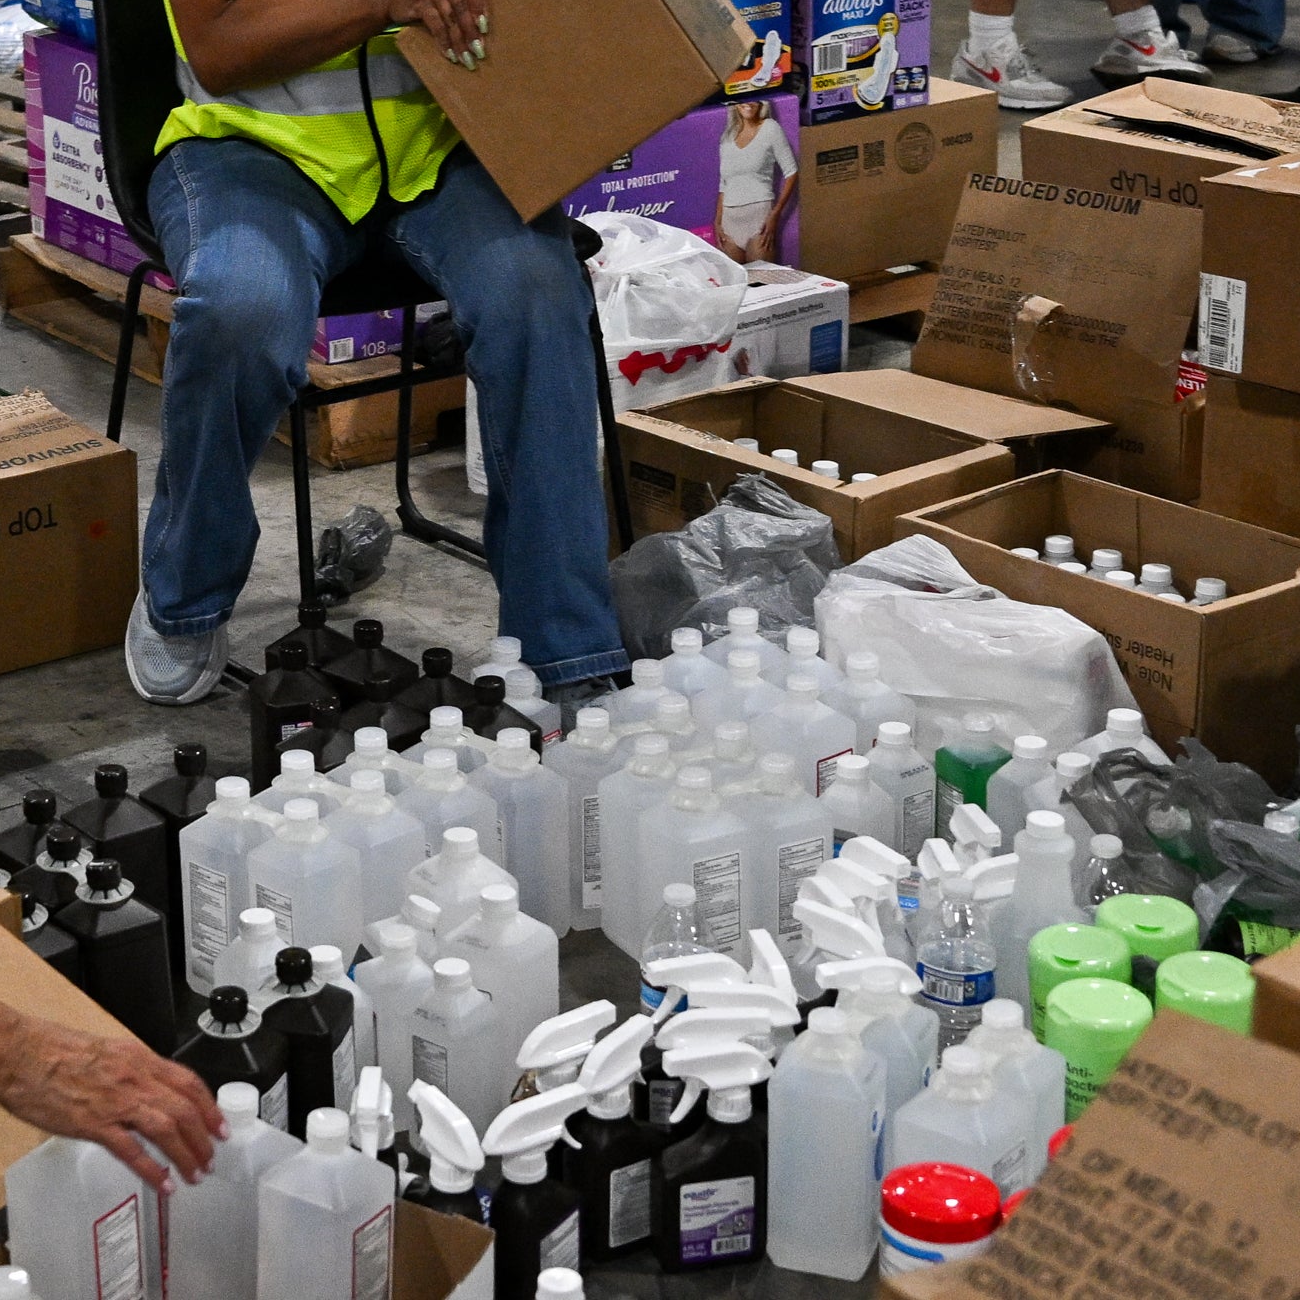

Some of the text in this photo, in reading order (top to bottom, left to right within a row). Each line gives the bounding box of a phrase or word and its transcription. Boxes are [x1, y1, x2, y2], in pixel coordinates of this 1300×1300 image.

[738, 1, 782, 15] DVANCED
[842, 10, 864, 21] MAXI
[814, 78, 836, 89] 100%
[61, 143, 80, 157] EXTRA
[51, 151, 91, 174] ABSORBENCY
[601, 181, 625, 194] TOTAL
[969, 173, 1142, 216] REDUCED SODIUM
[1109, 169, 1203, 208] OP FLAP
[954, 222, 984, 237] DATED
[955, 268, 971, 280] OF
[1009, 277, 1021, 288] 12
[933, 290, 982, 308] CONTRACT
[736, 315, 770, 330] Alternating
[771, 308, 797, 321] Pressure
[971, 323, 1011, 340] COMPAN
[360, 340, 386, 357] 108
[997, 340, 1013, 354] 452
[16, 406, 34, 416] OF
[8, 503, 58, 537] TOP
[1125, 639, 1174, 669] Heater
[1134, 663, 1173, 692] Note:
[1066, 1062, 1093, 1078] Anti-
[1122, 1058, 1192, 1100] ATED
[1079, 1148, 1124, 1175] OF
